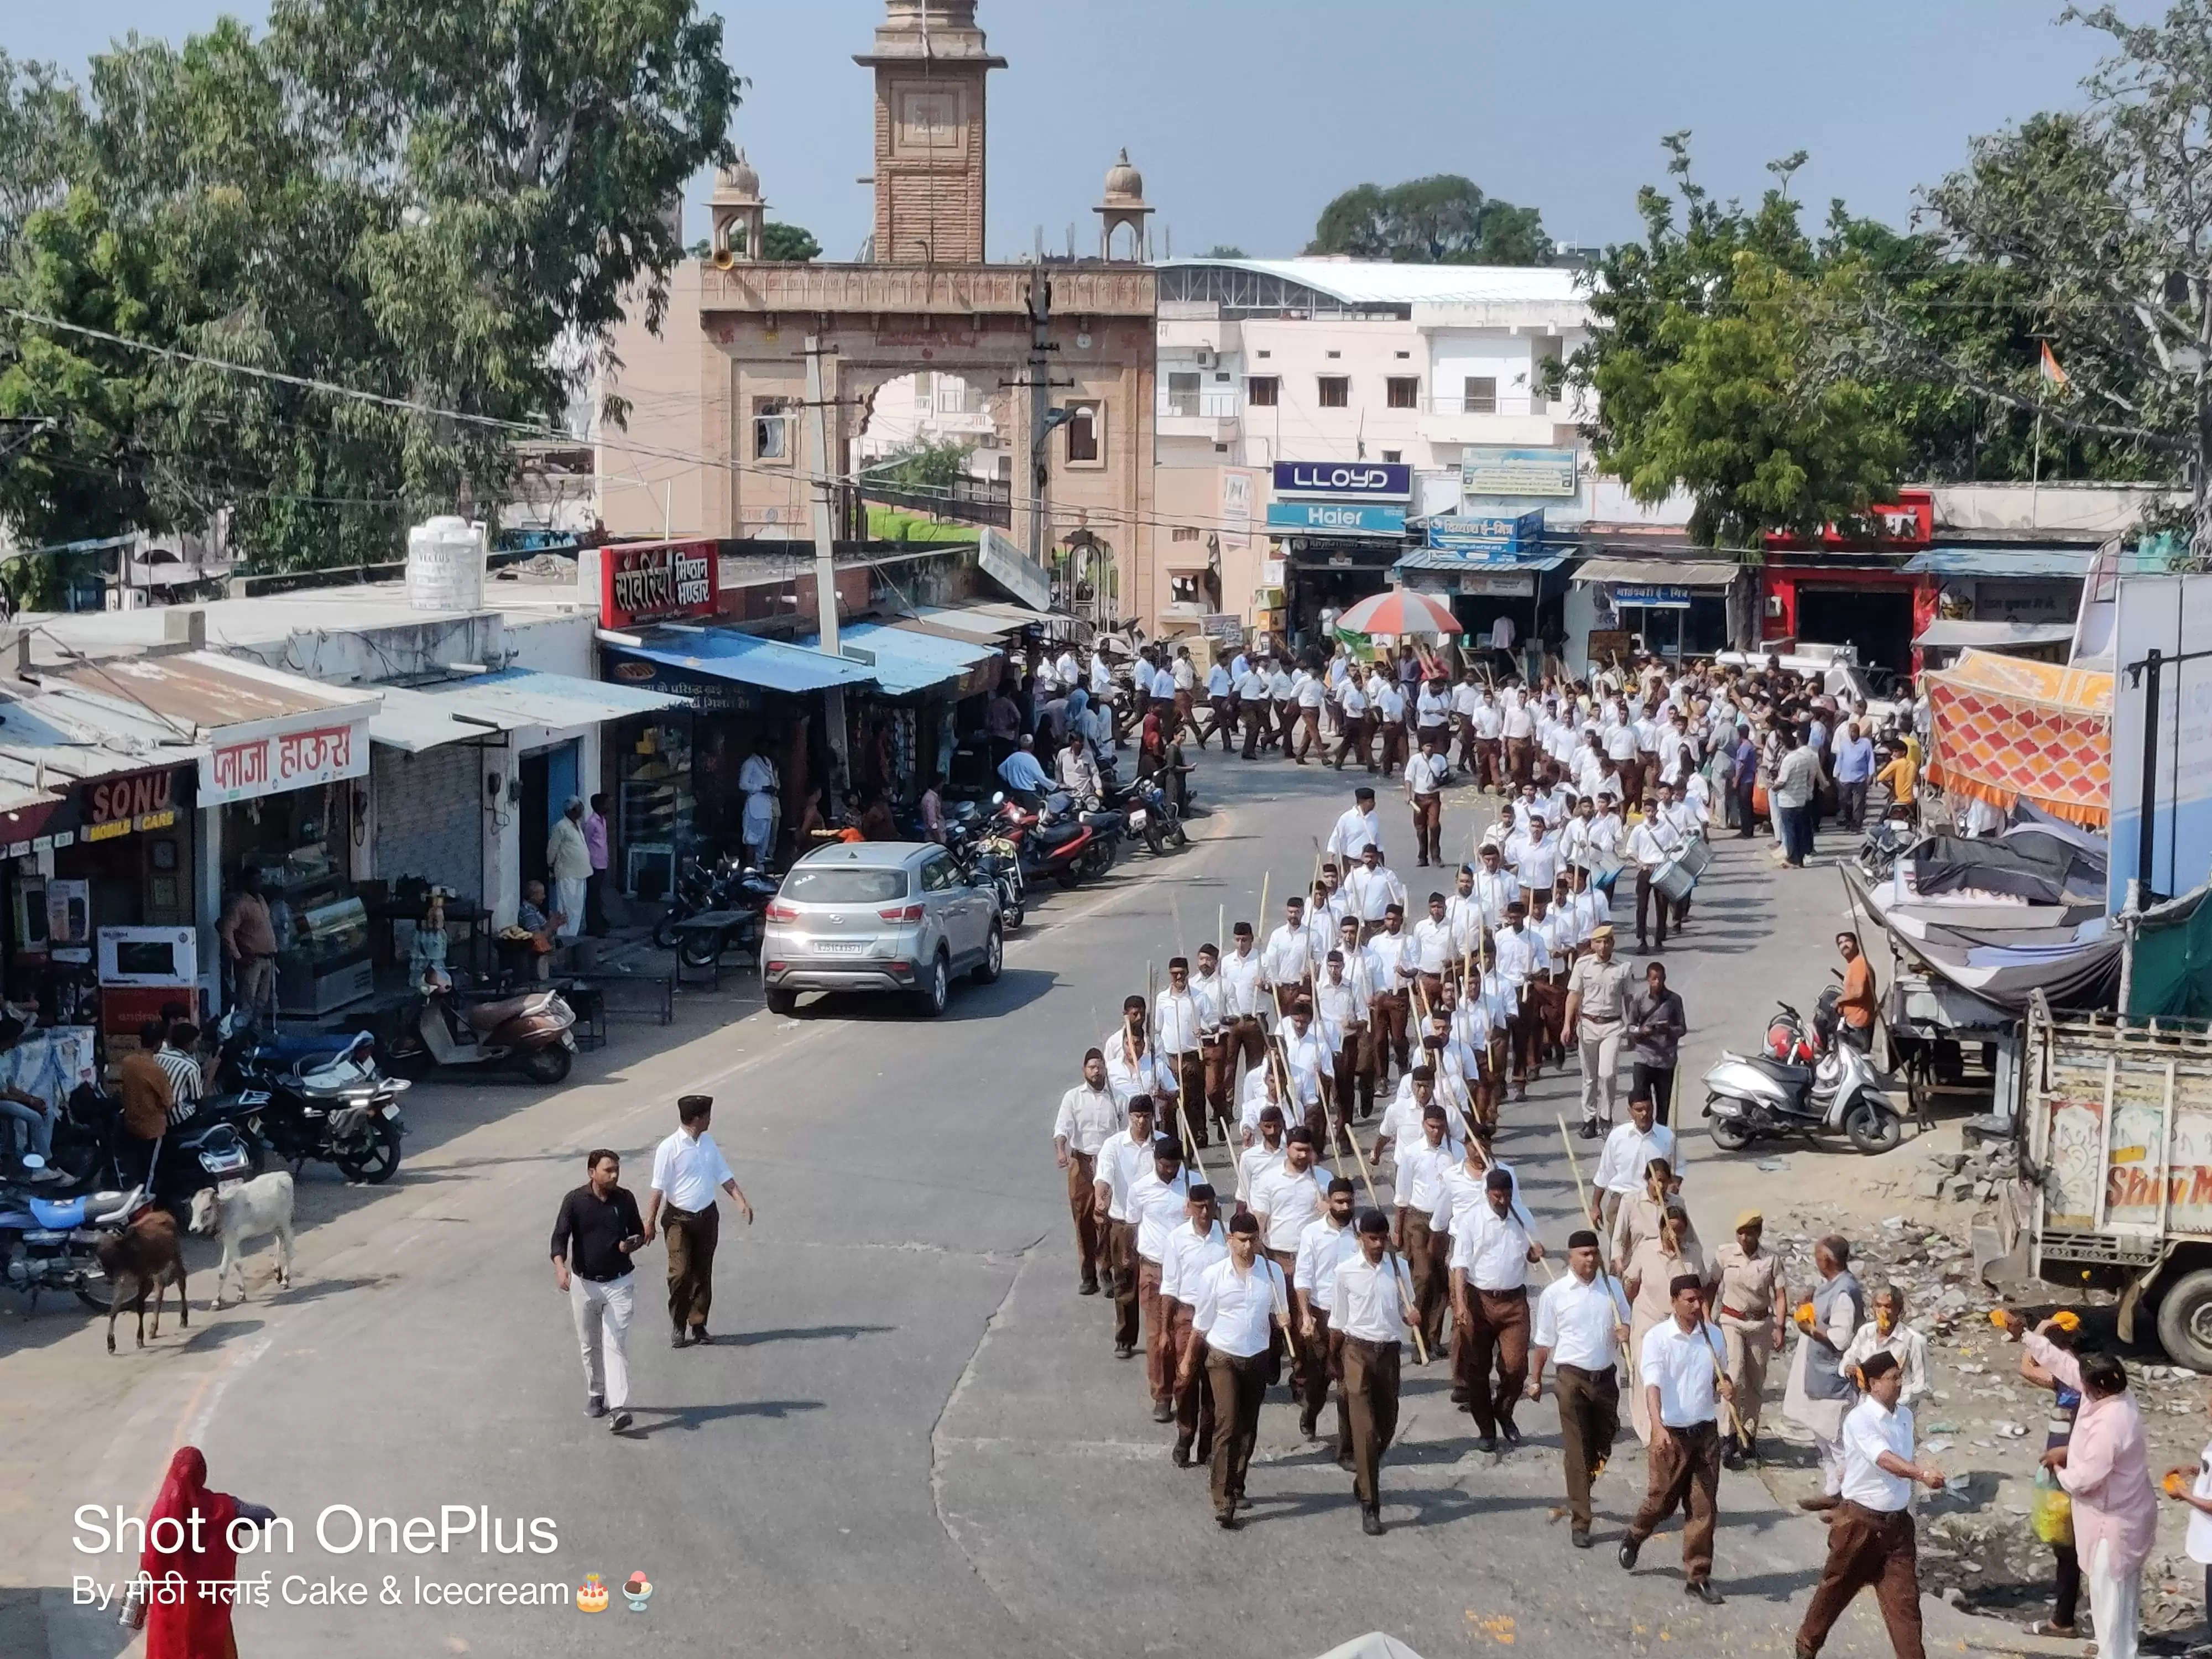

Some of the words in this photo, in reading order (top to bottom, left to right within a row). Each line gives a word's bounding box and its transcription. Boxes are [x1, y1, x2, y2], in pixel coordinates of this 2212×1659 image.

[1294, 467, 1388, 487] LLOYD
[1308, 508, 1363, 525] Haier
[212, 739, 270, 790] प्लाजा
[279, 725, 351, 779] हाऊस
[92, 771, 171, 824] SONU
[142, 810, 174, 830] CARE
